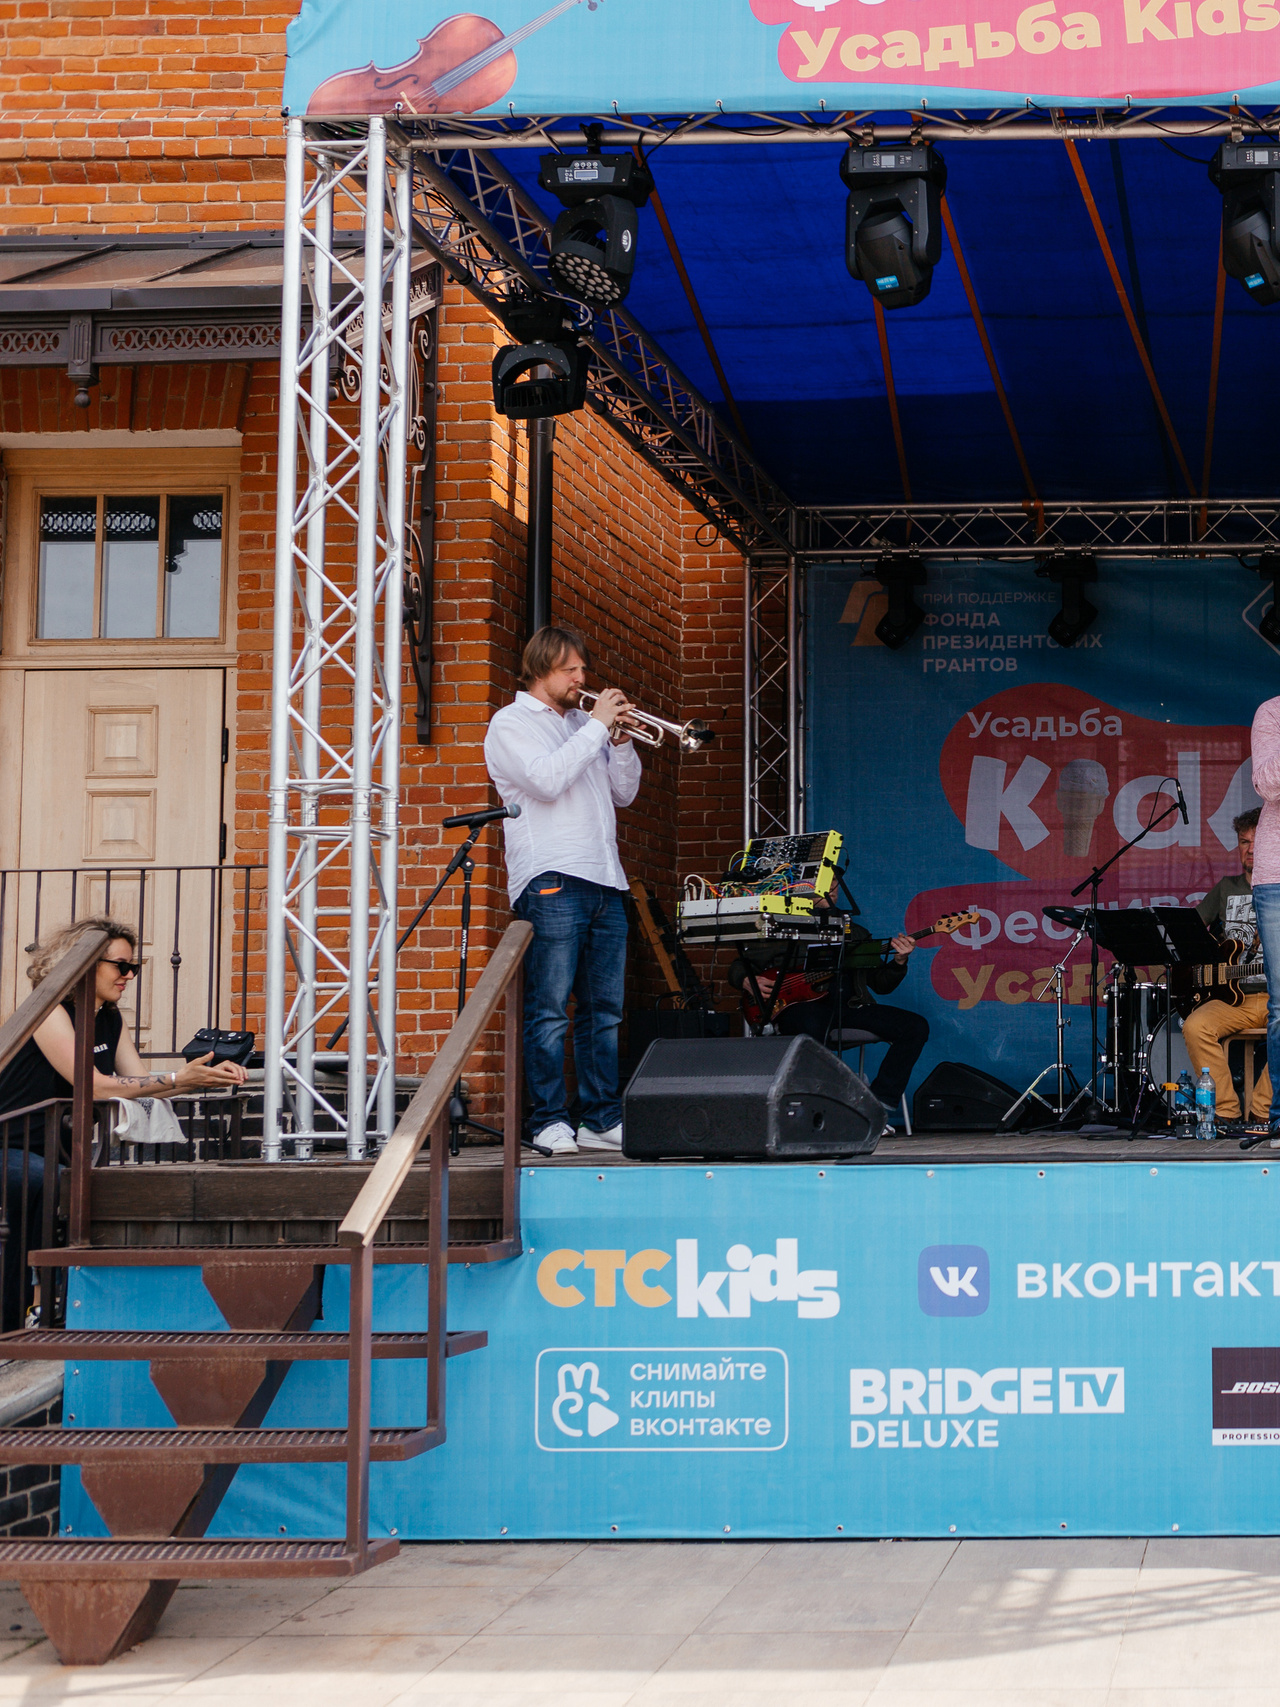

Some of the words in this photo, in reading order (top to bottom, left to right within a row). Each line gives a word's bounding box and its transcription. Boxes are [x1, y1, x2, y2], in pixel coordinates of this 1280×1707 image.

[790, 1, 1101, 78] Усадьба
[1124, 0, 1280, 44] Kids
[923, 593, 953, 605] ПРИ
[959, 592, 1056, 605] ПОДДЕРЖКЕ
[923, 612, 1001, 628] ФОНДА
[923, 633, 1104, 651] ПРЕЗИДЕНТСИХ
[923, 657, 1018, 673] ГРАНТОВ
[966, 708, 1123, 741] Усадьба
[951, 963, 1166, 1010] Усад
[630, 1356, 767, 1382] снимайте
[630, 1390, 716, 1409] клипы
[1065, 1373, 1118, 1407] TV
[630, 1416, 772, 1437] вконтакте
[850, 1419, 999, 1448] DELUXE
